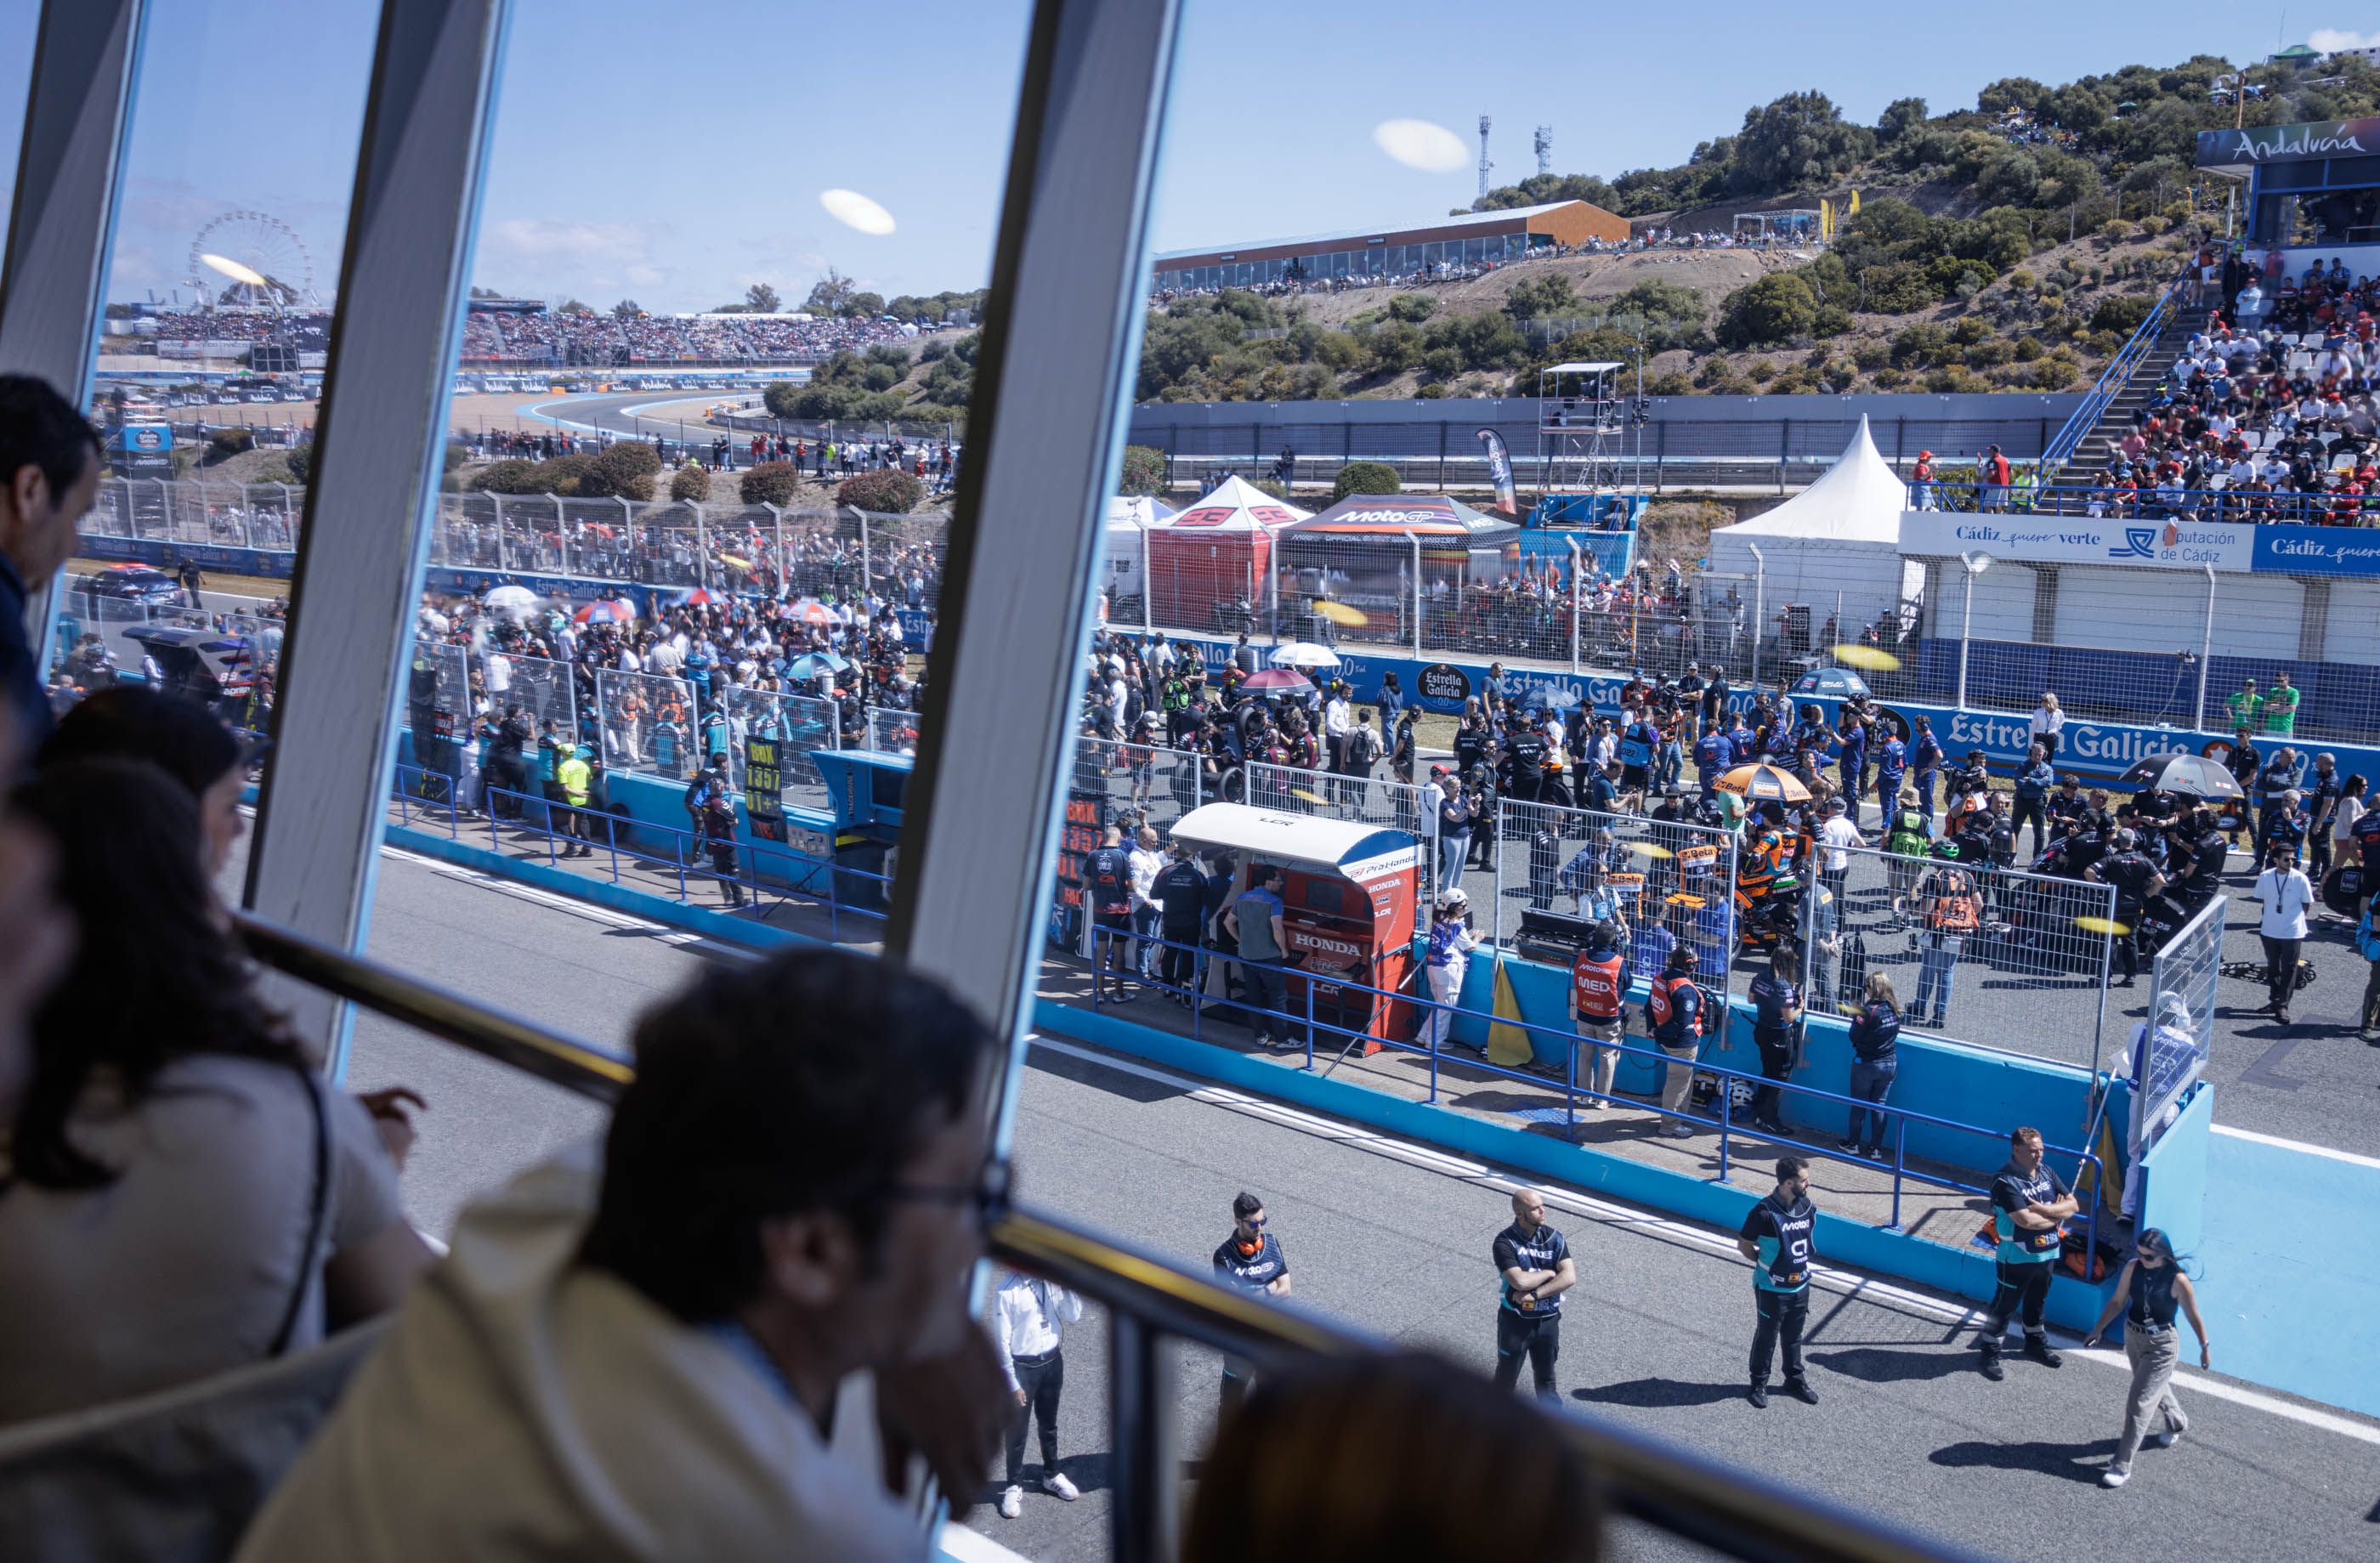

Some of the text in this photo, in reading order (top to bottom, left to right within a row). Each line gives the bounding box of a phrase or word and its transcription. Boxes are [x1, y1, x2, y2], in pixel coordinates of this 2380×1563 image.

[2233, 122, 2366, 161] Andalucía
[1333, 509, 1435, 524] MotoGP
[1956, 525, 2000, 541] Cádiz
[2059, 532, 2101, 545] verte
[2162, 528, 2236, 545] putación
[2270, 539, 2325, 556] Cádiz
[2161, 549, 2220, 563] de Cádiz
[1425, 671, 1462, 686] Estrella
[1426, 683, 1460, 698] Galicia
[1947, 713, 2066, 754] Estrela
[1726, 782, 1748, 795] Beta
[1791, 789, 1809, 798] Beta
[1691, 846, 1715, 858] Beta
[1368, 878, 1402, 894] HONDA
[1295, 933, 1362, 957] HONDA
[1578, 976, 1611, 993] MED
